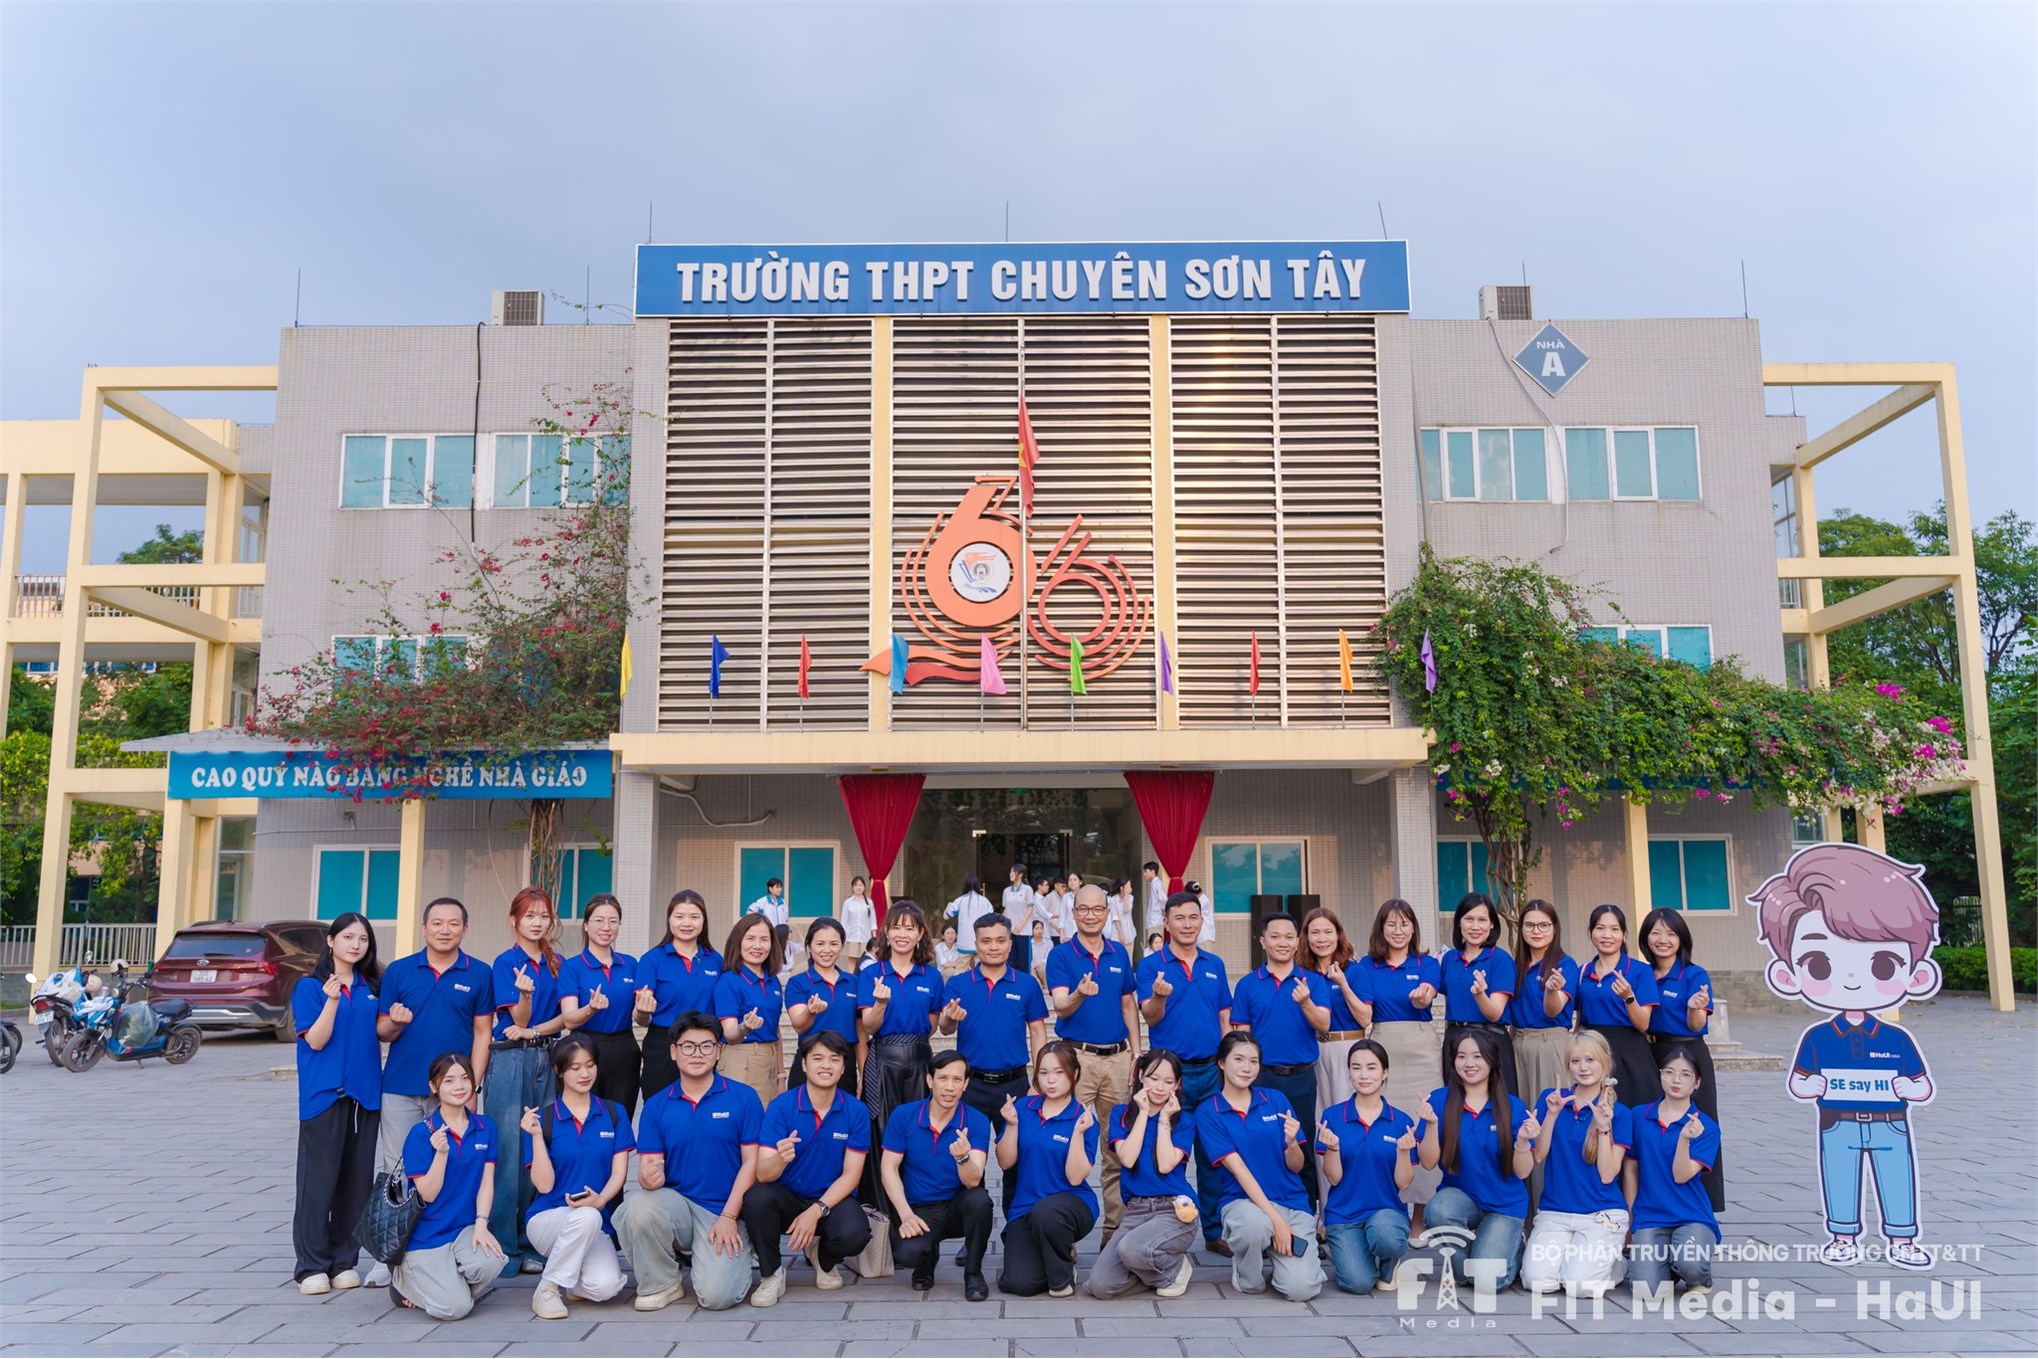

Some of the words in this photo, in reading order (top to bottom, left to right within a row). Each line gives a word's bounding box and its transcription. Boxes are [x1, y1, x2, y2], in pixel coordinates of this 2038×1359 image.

[677, 251, 850, 303] TRƯỜNG
[866, 260, 974, 302] THPT
[991, 251, 1166, 301] CHUYÊN
[1185, 254, 1272, 300] SƠN
[1287, 250, 1366, 299] TÂY
[1536, 339, 1565, 349] NHÀ
[1541, 352, 1566, 376] A
[191, 766, 237, 788] CAO
[241, 761, 289, 791] QUÝ
[478, 761, 526, 787] NHÀ
[531, 761, 587, 787] GIÁO
[1830, 1078, 1846, 1090] SE
[1849, 1080, 1872, 1093] say
[1875, 1080, 1889, 1091] HI
